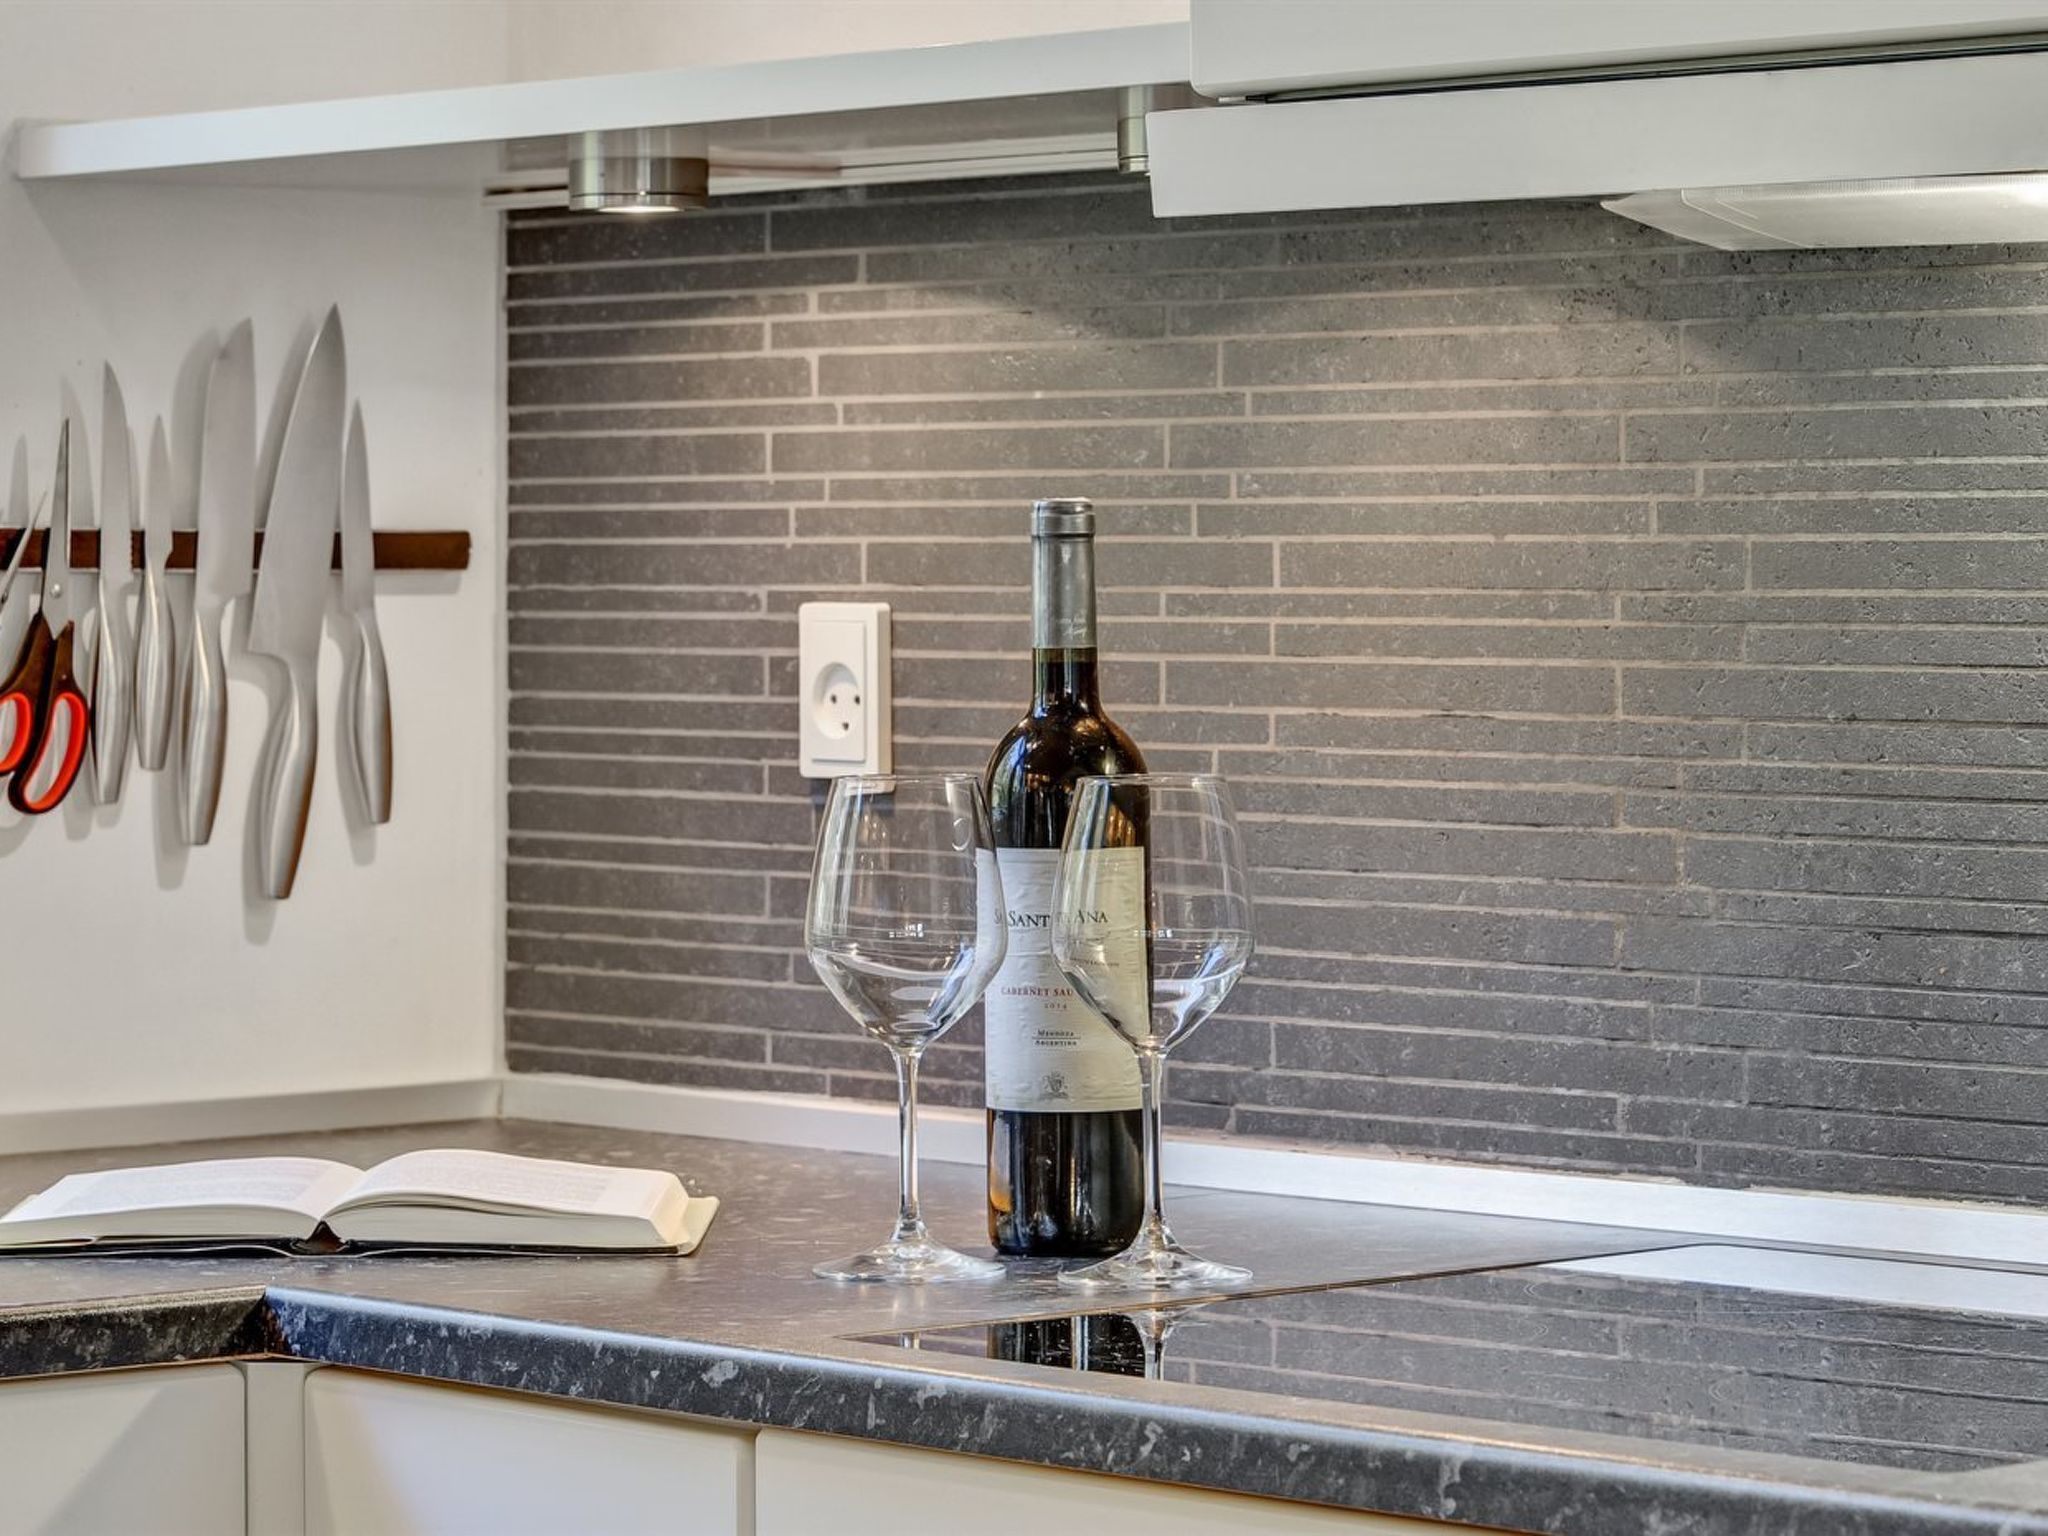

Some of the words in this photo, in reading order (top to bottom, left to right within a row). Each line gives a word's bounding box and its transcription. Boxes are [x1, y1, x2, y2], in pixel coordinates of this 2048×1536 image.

[1008, 909, 1051, 927] SANT
[1001, 985, 1049, 997] CABERNET
[1053, 986, 1073, 997] SAU
